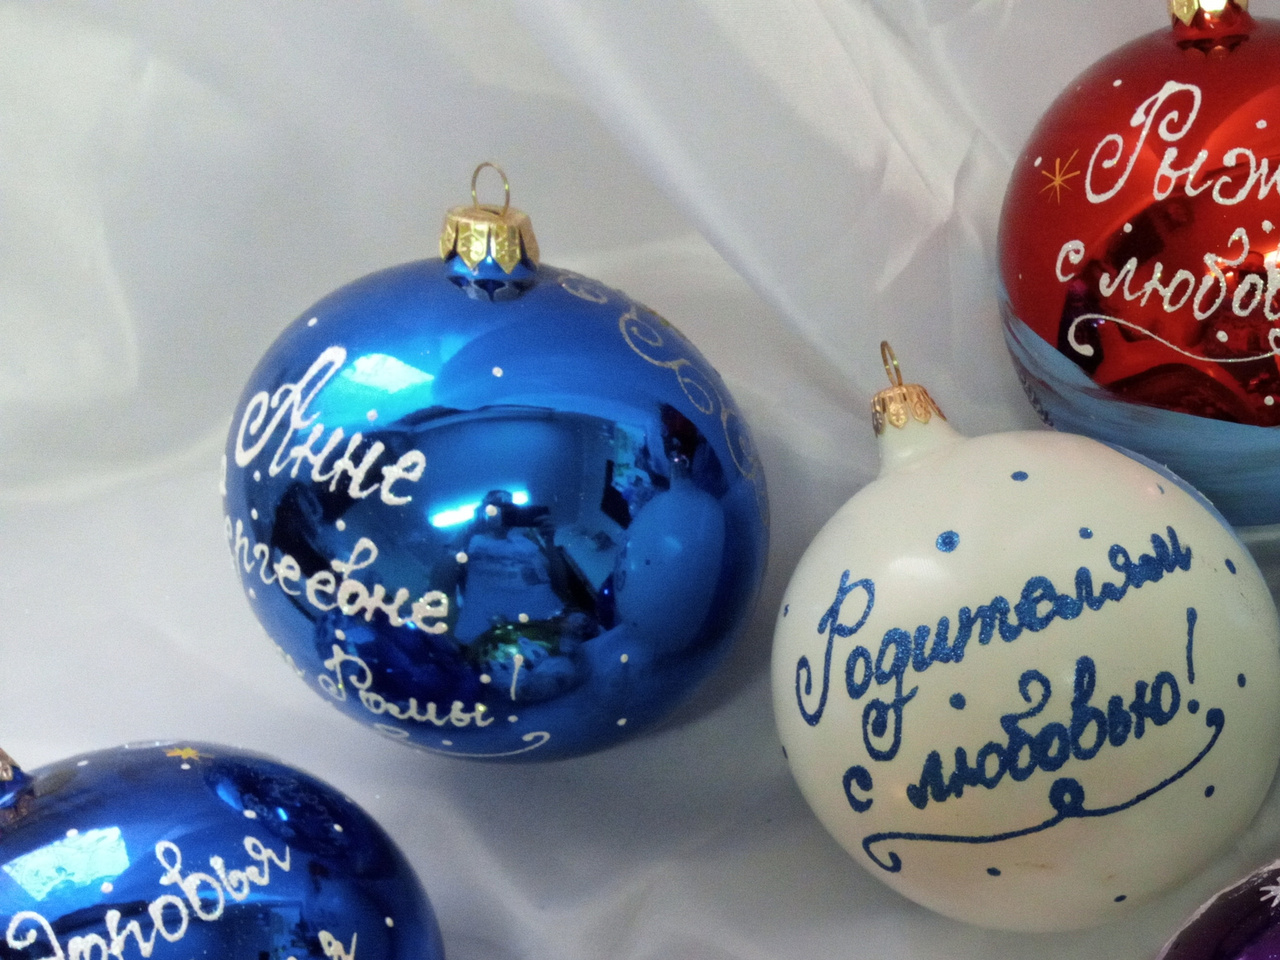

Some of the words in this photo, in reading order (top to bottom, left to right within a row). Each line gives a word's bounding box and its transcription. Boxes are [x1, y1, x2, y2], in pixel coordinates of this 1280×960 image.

[1056, 240, 1085, 283] с
[234, 346, 426, 505] Анне
[842, 765, 874, 814] с
[906, 606, 1202, 810] любовью!
